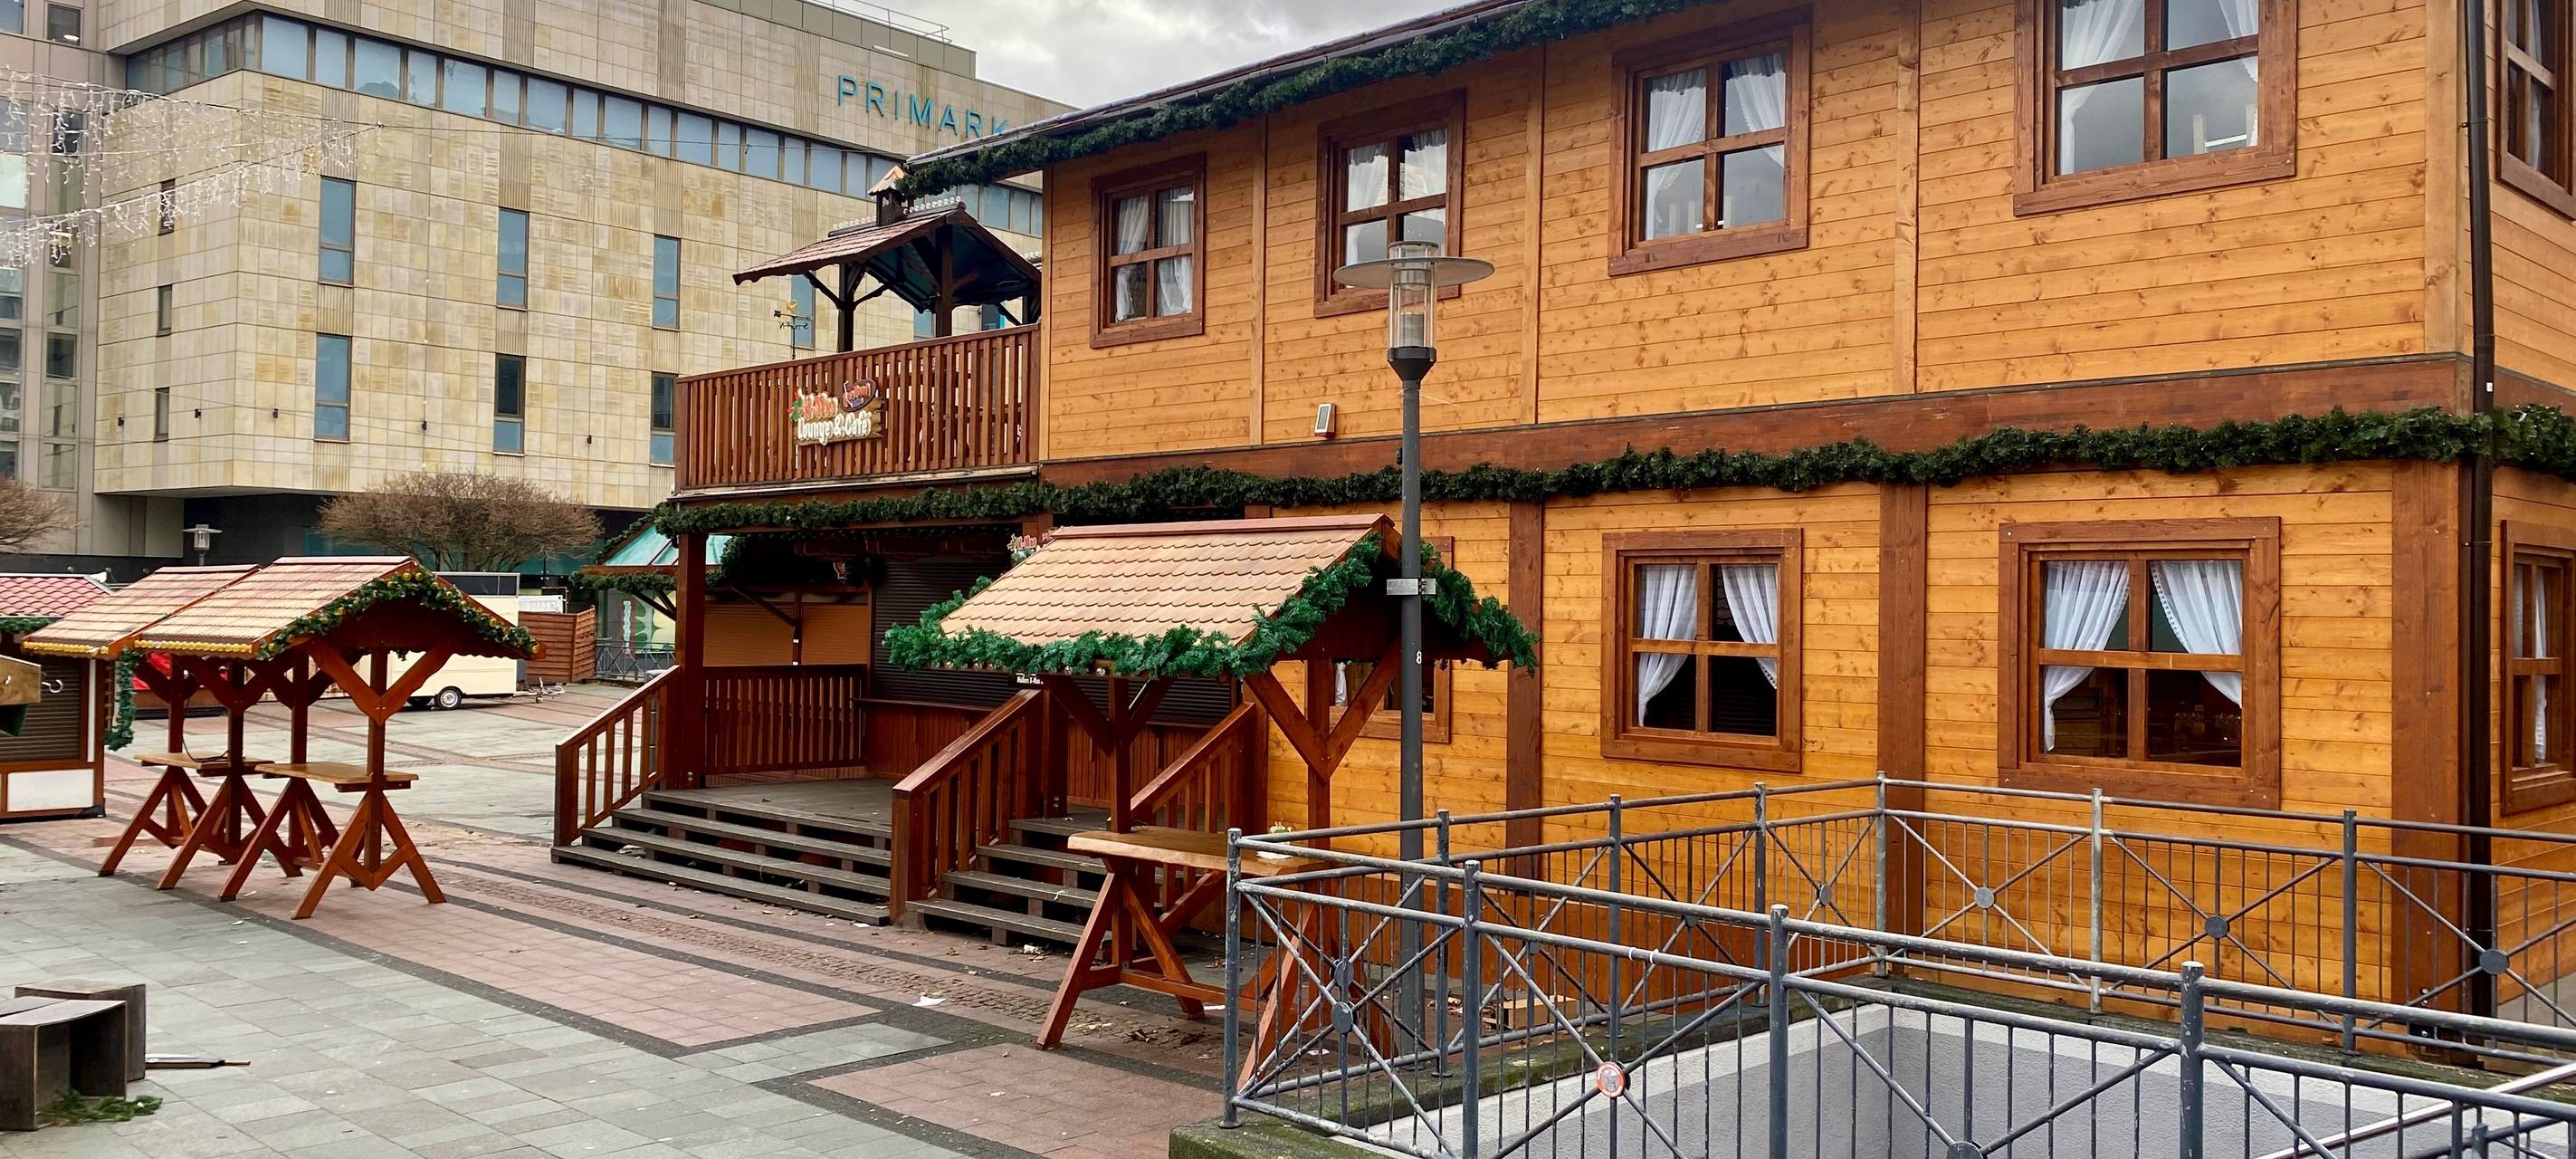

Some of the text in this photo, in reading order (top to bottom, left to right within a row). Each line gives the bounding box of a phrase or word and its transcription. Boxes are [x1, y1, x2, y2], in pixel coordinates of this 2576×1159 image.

[838, 74, 1011, 139] PRIMARK
[797, 410, 872, 445] Lounge & Café
[1416, 650, 1422, 665] 8
